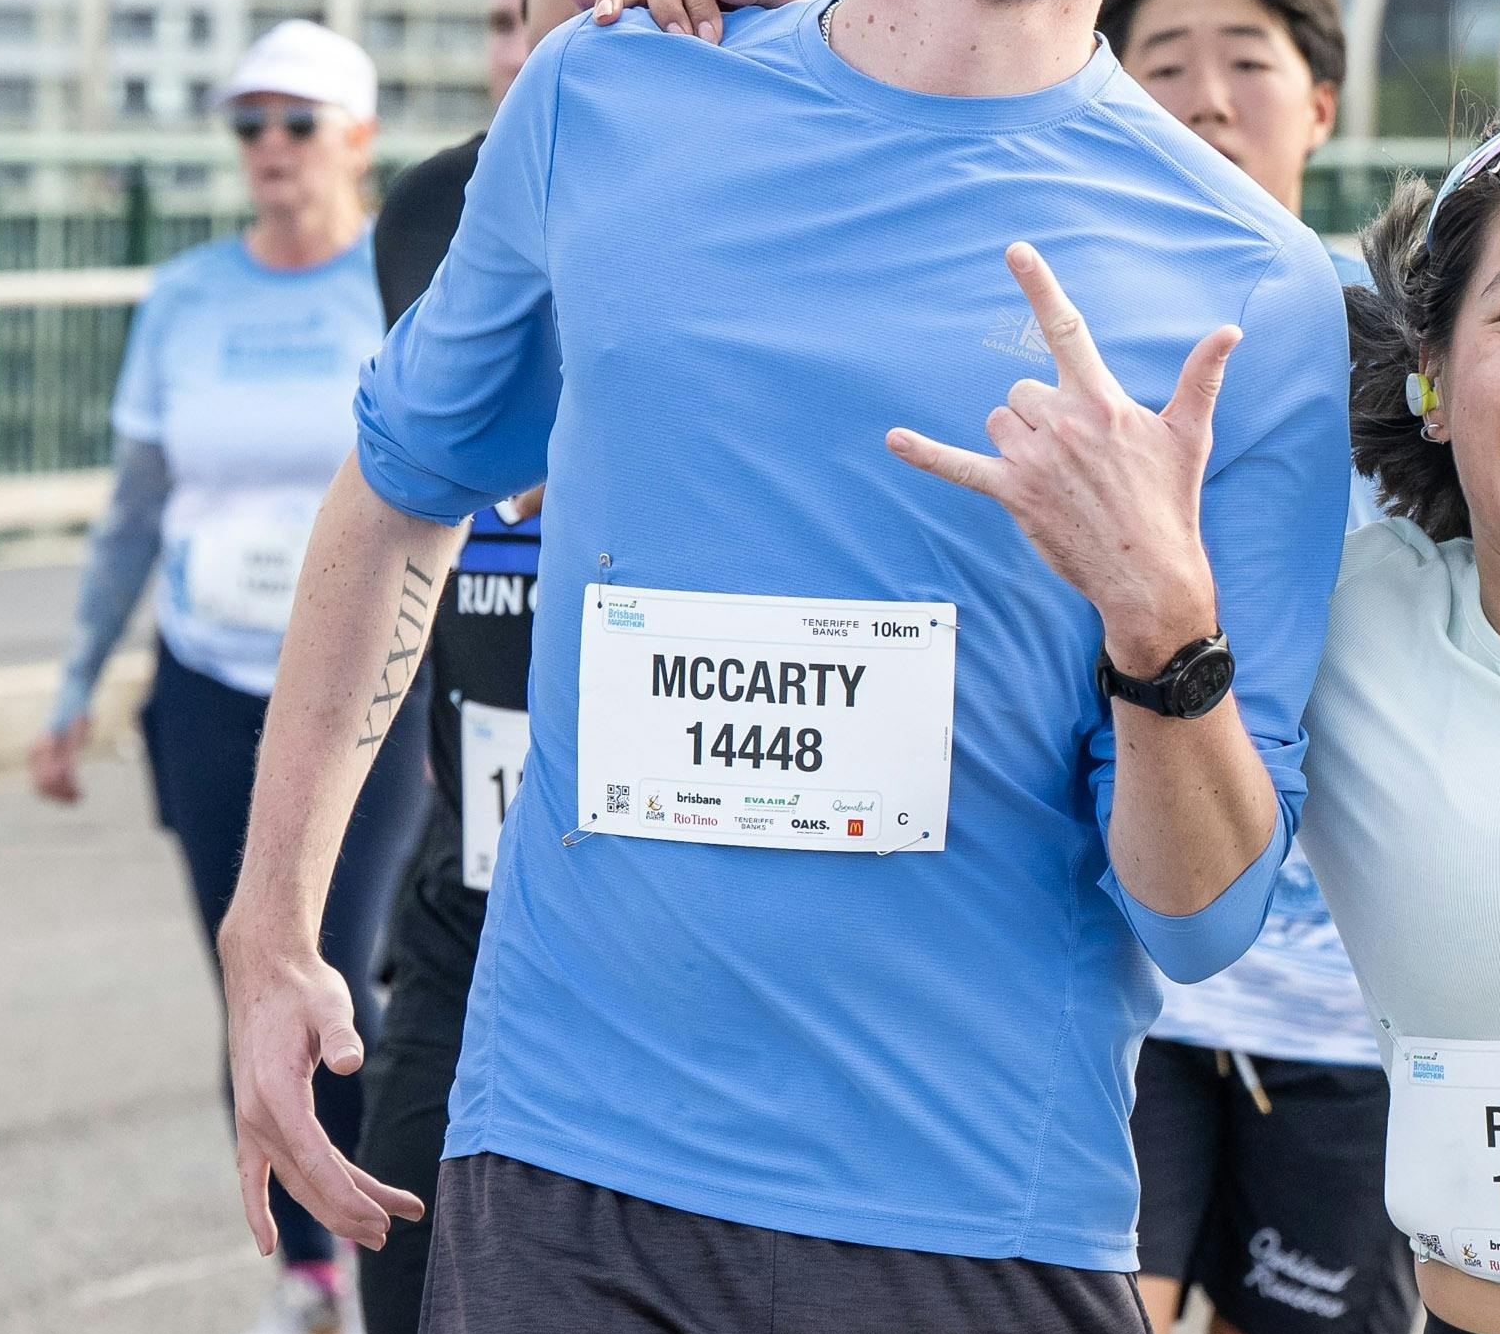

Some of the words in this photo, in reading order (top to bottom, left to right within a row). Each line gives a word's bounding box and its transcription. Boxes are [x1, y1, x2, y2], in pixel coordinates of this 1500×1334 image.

[457, 574, 524, 616] RUN
[608, 608, 644, 621] Brisbane
[802, 618, 859, 629] TENERIFFE
[871, 621, 920, 638] 10km
[812, 627, 848, 637] BANKS
[652, 653, 867, 708] MCCARTY
[685, 721, 824, 773] 14448
[677, 792, 722, 805] brisbane
[734, 816, 775, 826] TENERIFFE
[897, 812, 909, 826] C
[741, 823, 767, 831] BANKS
